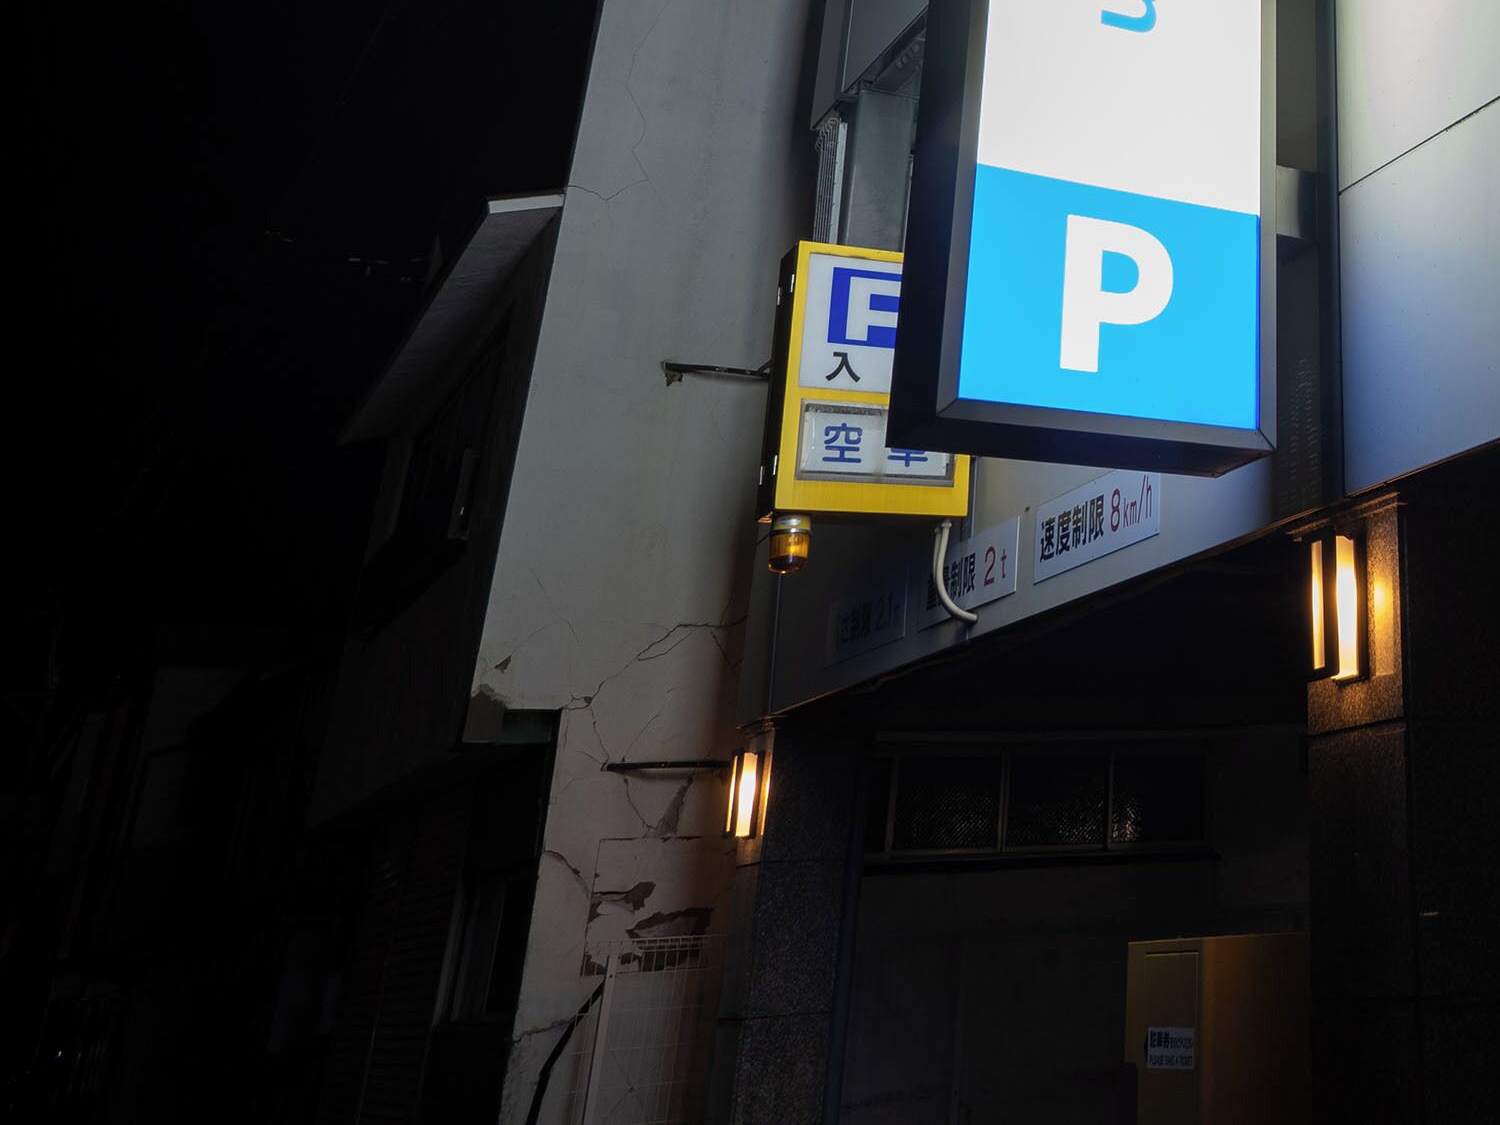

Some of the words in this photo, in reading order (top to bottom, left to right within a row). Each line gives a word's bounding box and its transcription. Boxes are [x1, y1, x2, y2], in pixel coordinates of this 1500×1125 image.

[1059, 213, 1175, 373] P
[1040, 494, 1105, 563] 速度制限
